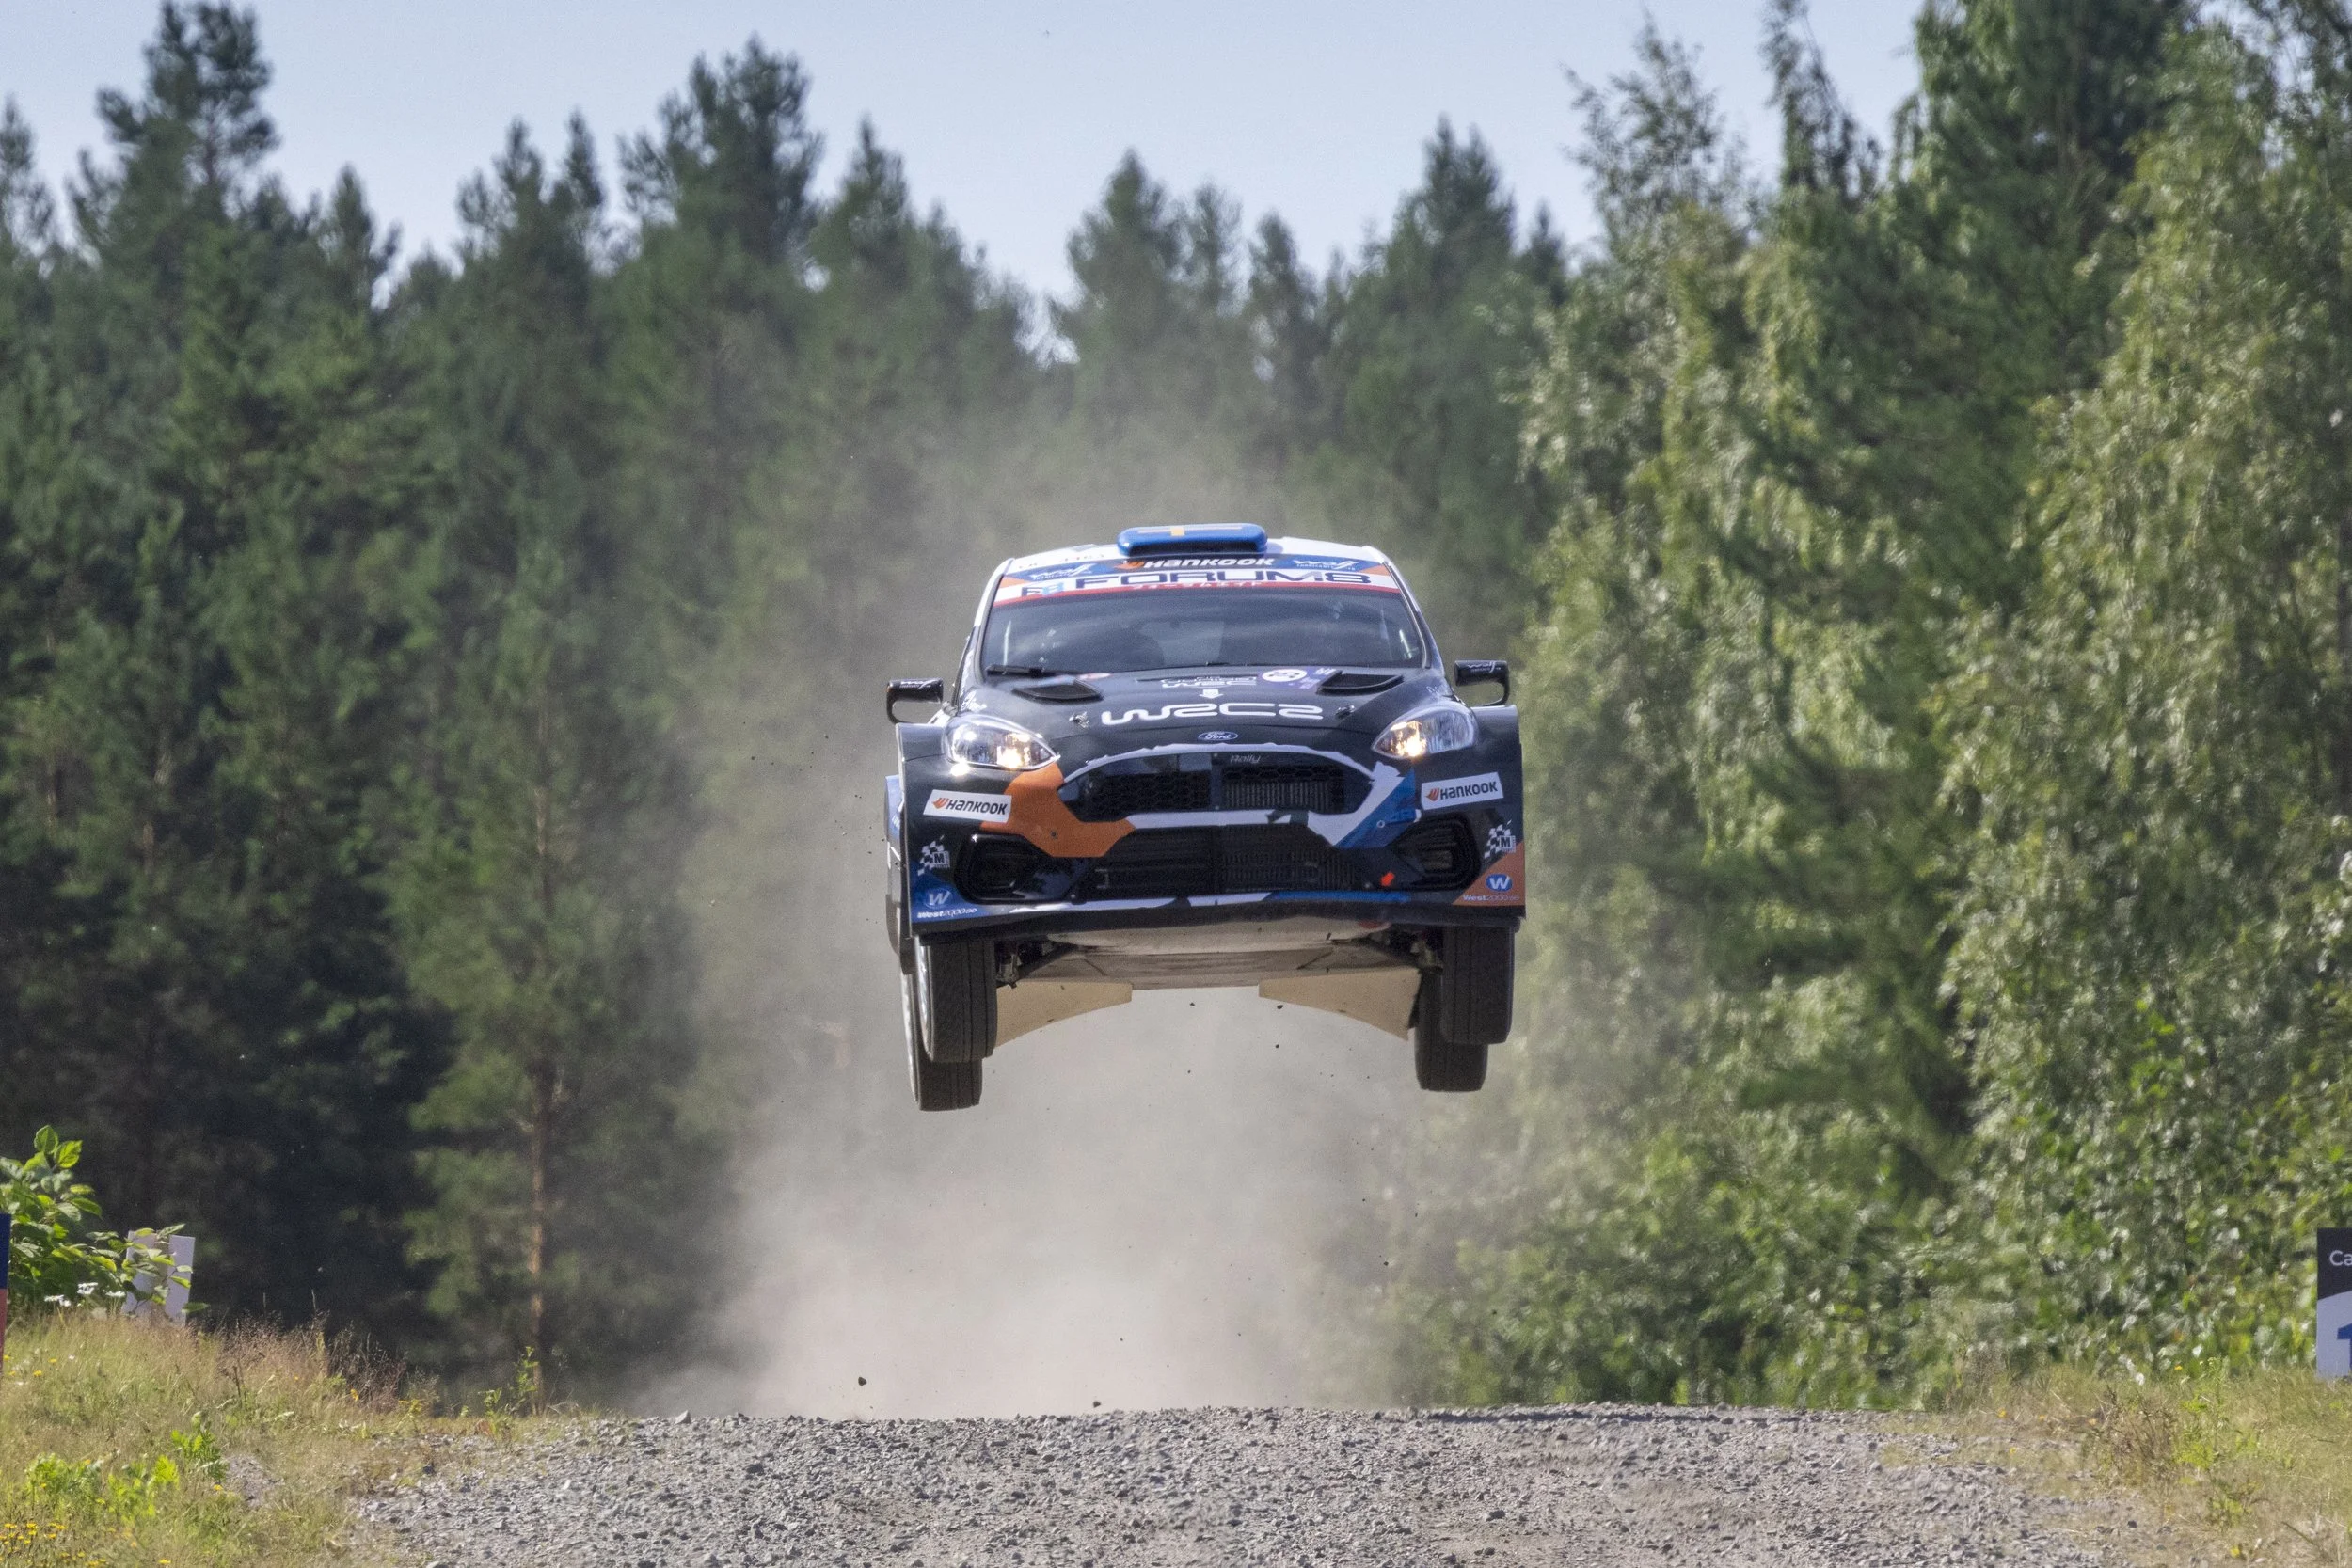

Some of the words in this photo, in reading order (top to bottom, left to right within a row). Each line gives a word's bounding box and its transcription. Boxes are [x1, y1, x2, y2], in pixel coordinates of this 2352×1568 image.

[1076, 570, 1372, 589] FORUM8
[1102, 703, 1324, 724] WRC2
[1205, 732, 1232, 740] Ford
[1489, 876, 1510, 890] W
[929, 890, 951, 905] W
